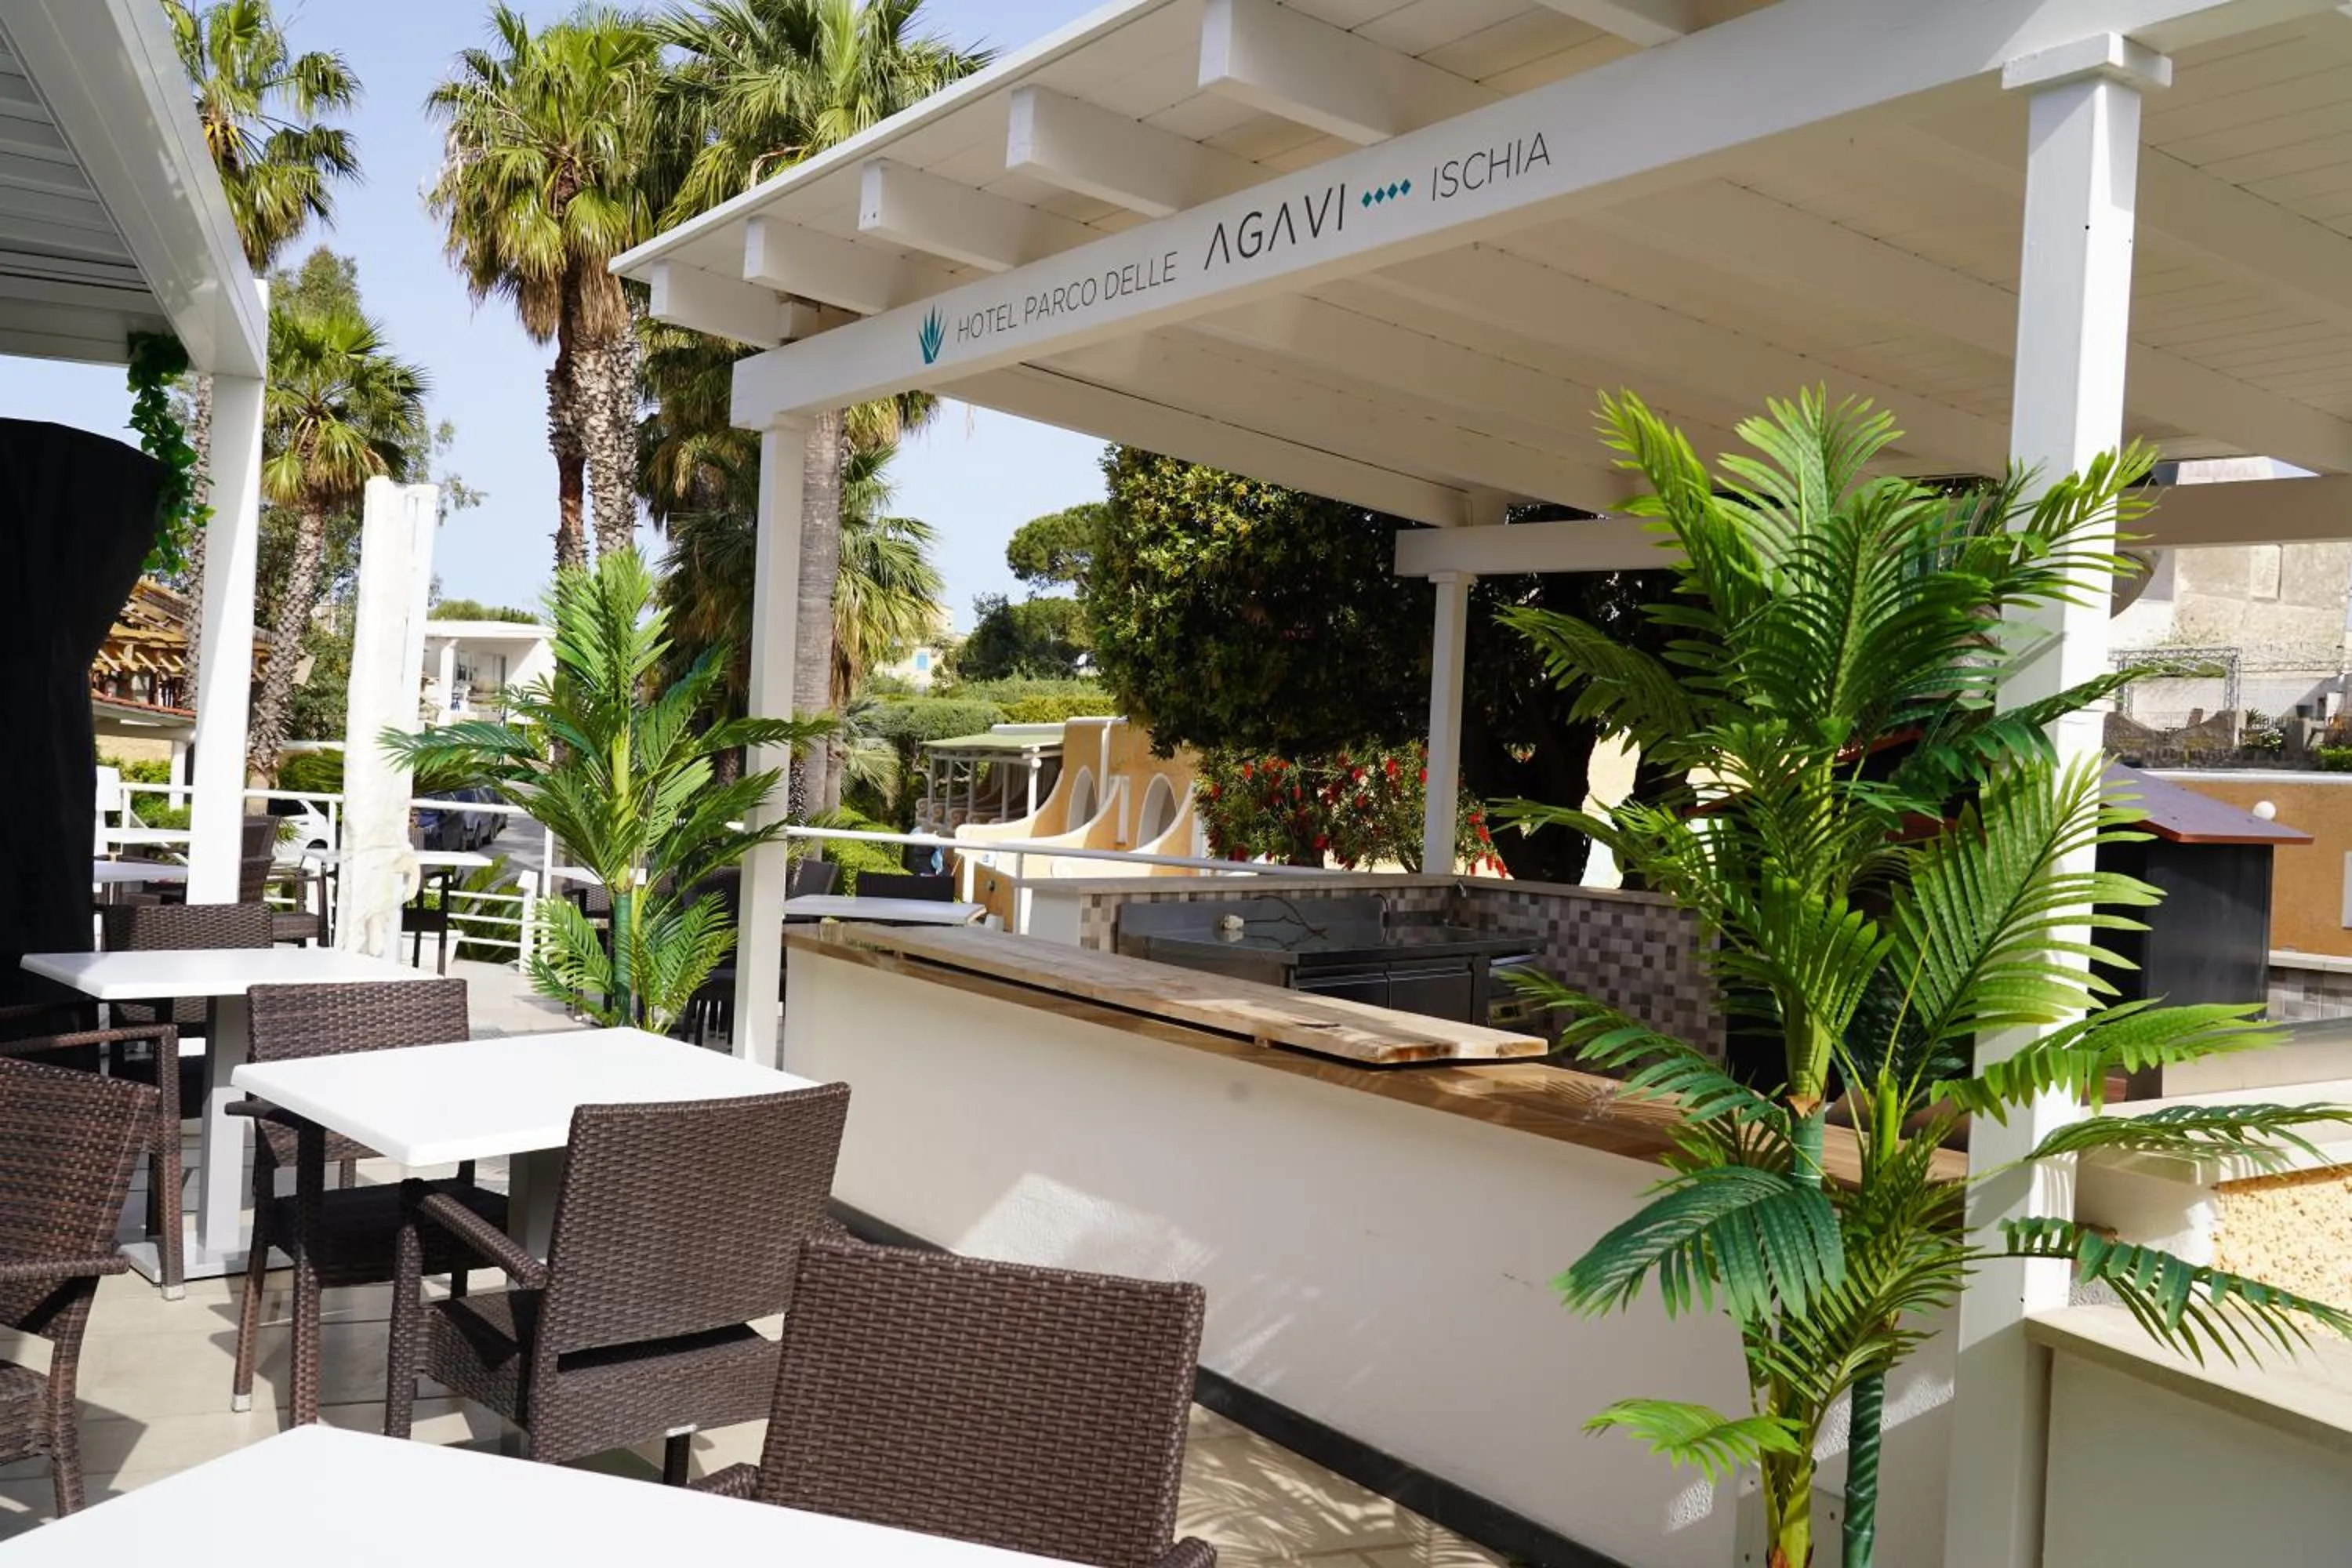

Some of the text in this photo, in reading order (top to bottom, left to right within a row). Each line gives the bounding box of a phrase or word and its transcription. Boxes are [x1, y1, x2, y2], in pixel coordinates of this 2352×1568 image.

[957, 132, 1551, 343] HOTEL PARCO DELLE AGAVI ISCHIA
